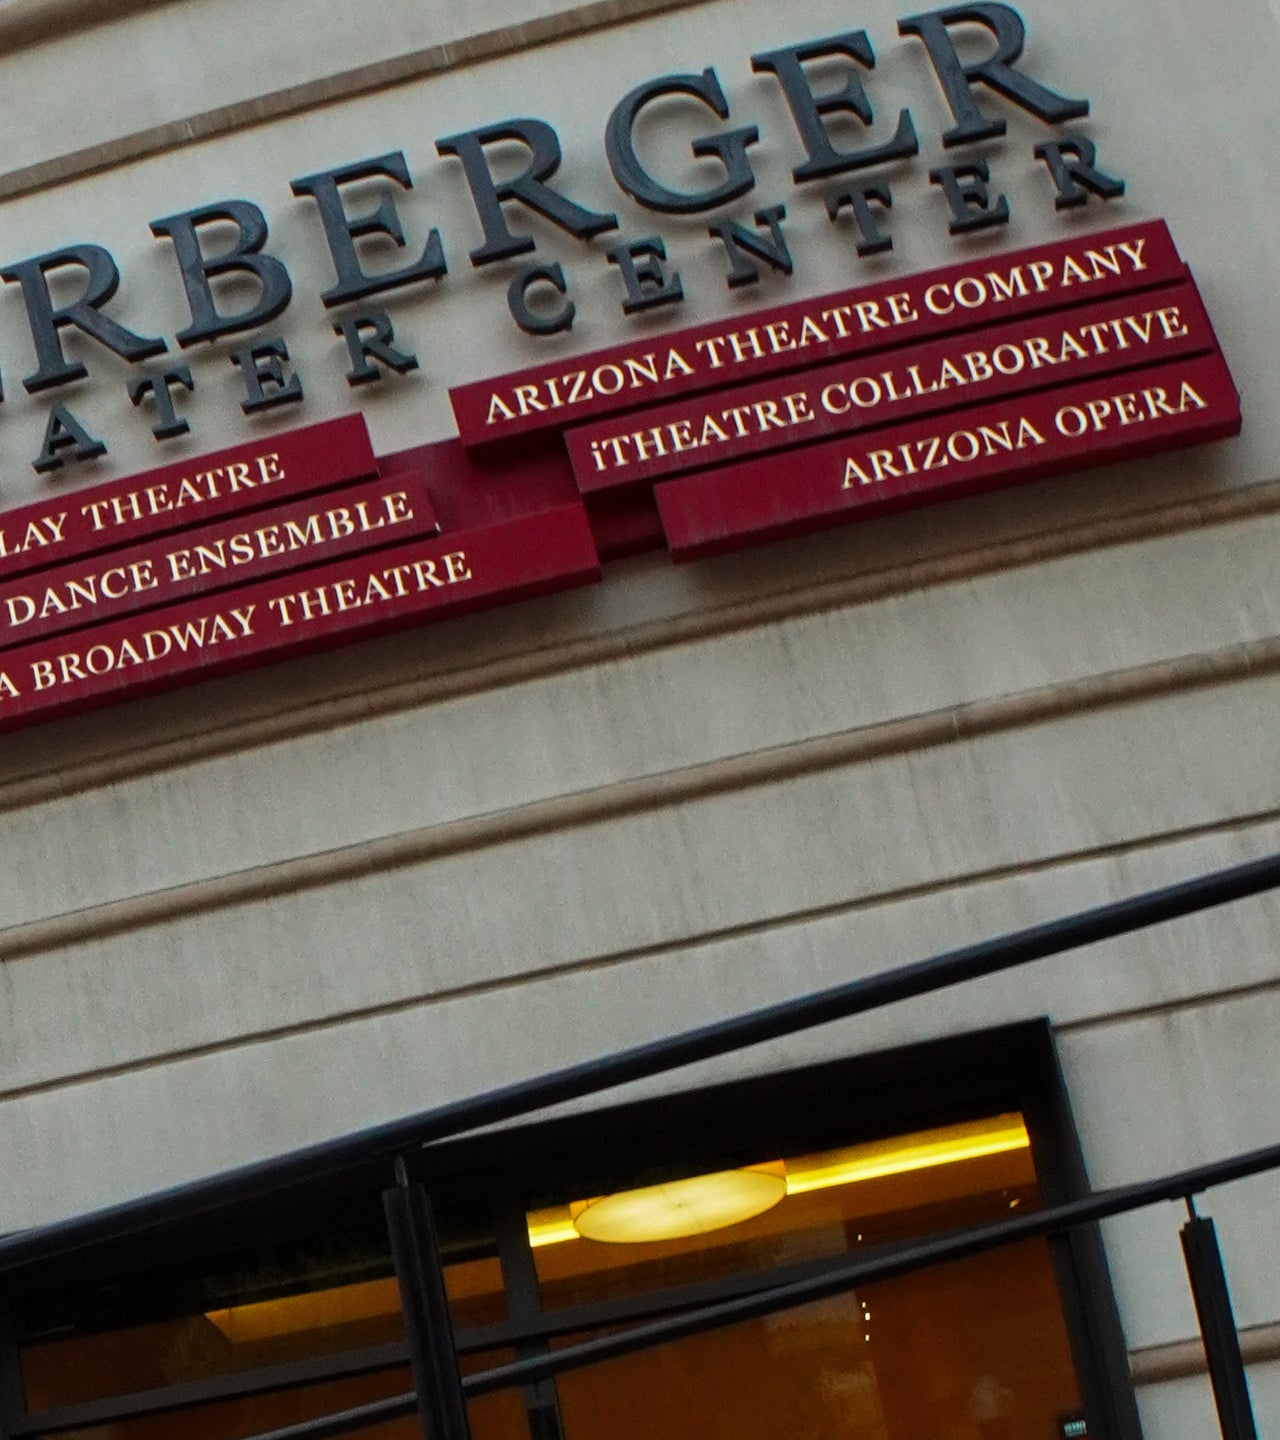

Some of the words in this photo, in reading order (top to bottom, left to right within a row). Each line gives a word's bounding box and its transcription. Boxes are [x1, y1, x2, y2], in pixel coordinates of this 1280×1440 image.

[508, 135, 1125, 338] CENTER
[487, 350, 693, 424] ARIZONA
[696, 293, 918, 367] THEATRE
[925, 240, 1145, 314] COMPANY
[592, 393, 814, 470] iTHEATRE
[822, 307, 1187, 413] COLLABORATIVE
[82, 454, 284, 530] THEATRE
[843, 419, 1044, 488] ARIZONA
[1055, 382, 1205, 435] OPERA
[6, 560, 158, 626] DANCE
[166, 492, 413, 581] ENSEMBLE
[31, 605, 255, 690] BROADWAY
[269, 552, 471, 625] THEATRE
